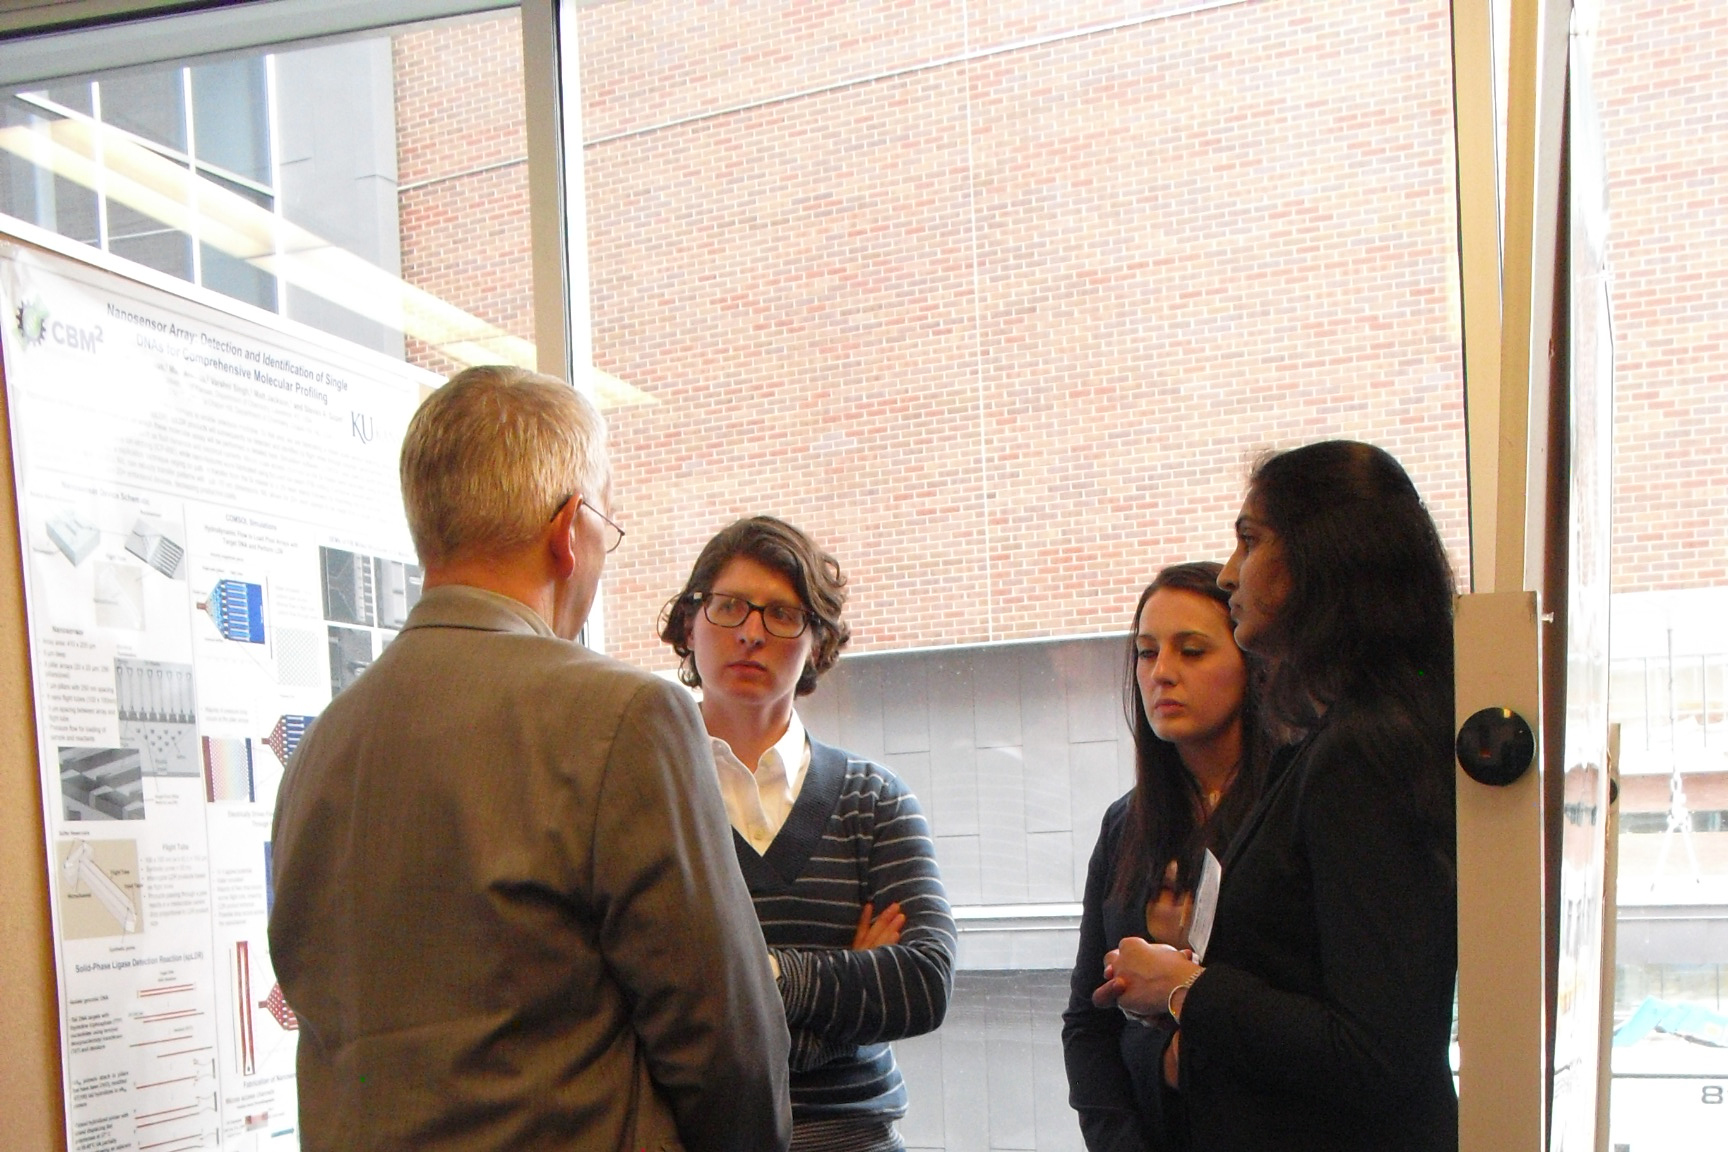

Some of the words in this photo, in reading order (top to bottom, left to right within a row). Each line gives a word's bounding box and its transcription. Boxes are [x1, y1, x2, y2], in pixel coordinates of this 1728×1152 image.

[106, 303, 168, 333] Nanosensor
[169, 323, 198, 344] Array:
[200, 332, 243, 359] Detection
[244, 348, 261, 363] and
[262, 352, 314, 378] Identification
[315, 370, 324, 382] of
[325, 372, 348, 393] Single
[136, 333, 164, 353] DNAs
[166, 341, 181, 358] for
[182, 347, 252, 380] Comprehensive
[253, 370, 294, 392] Molecular
[295, 382, 328, 405] Profiling
[351, 410, 374, 444] KU
[1701, 1085, 1728, 1105] 8
